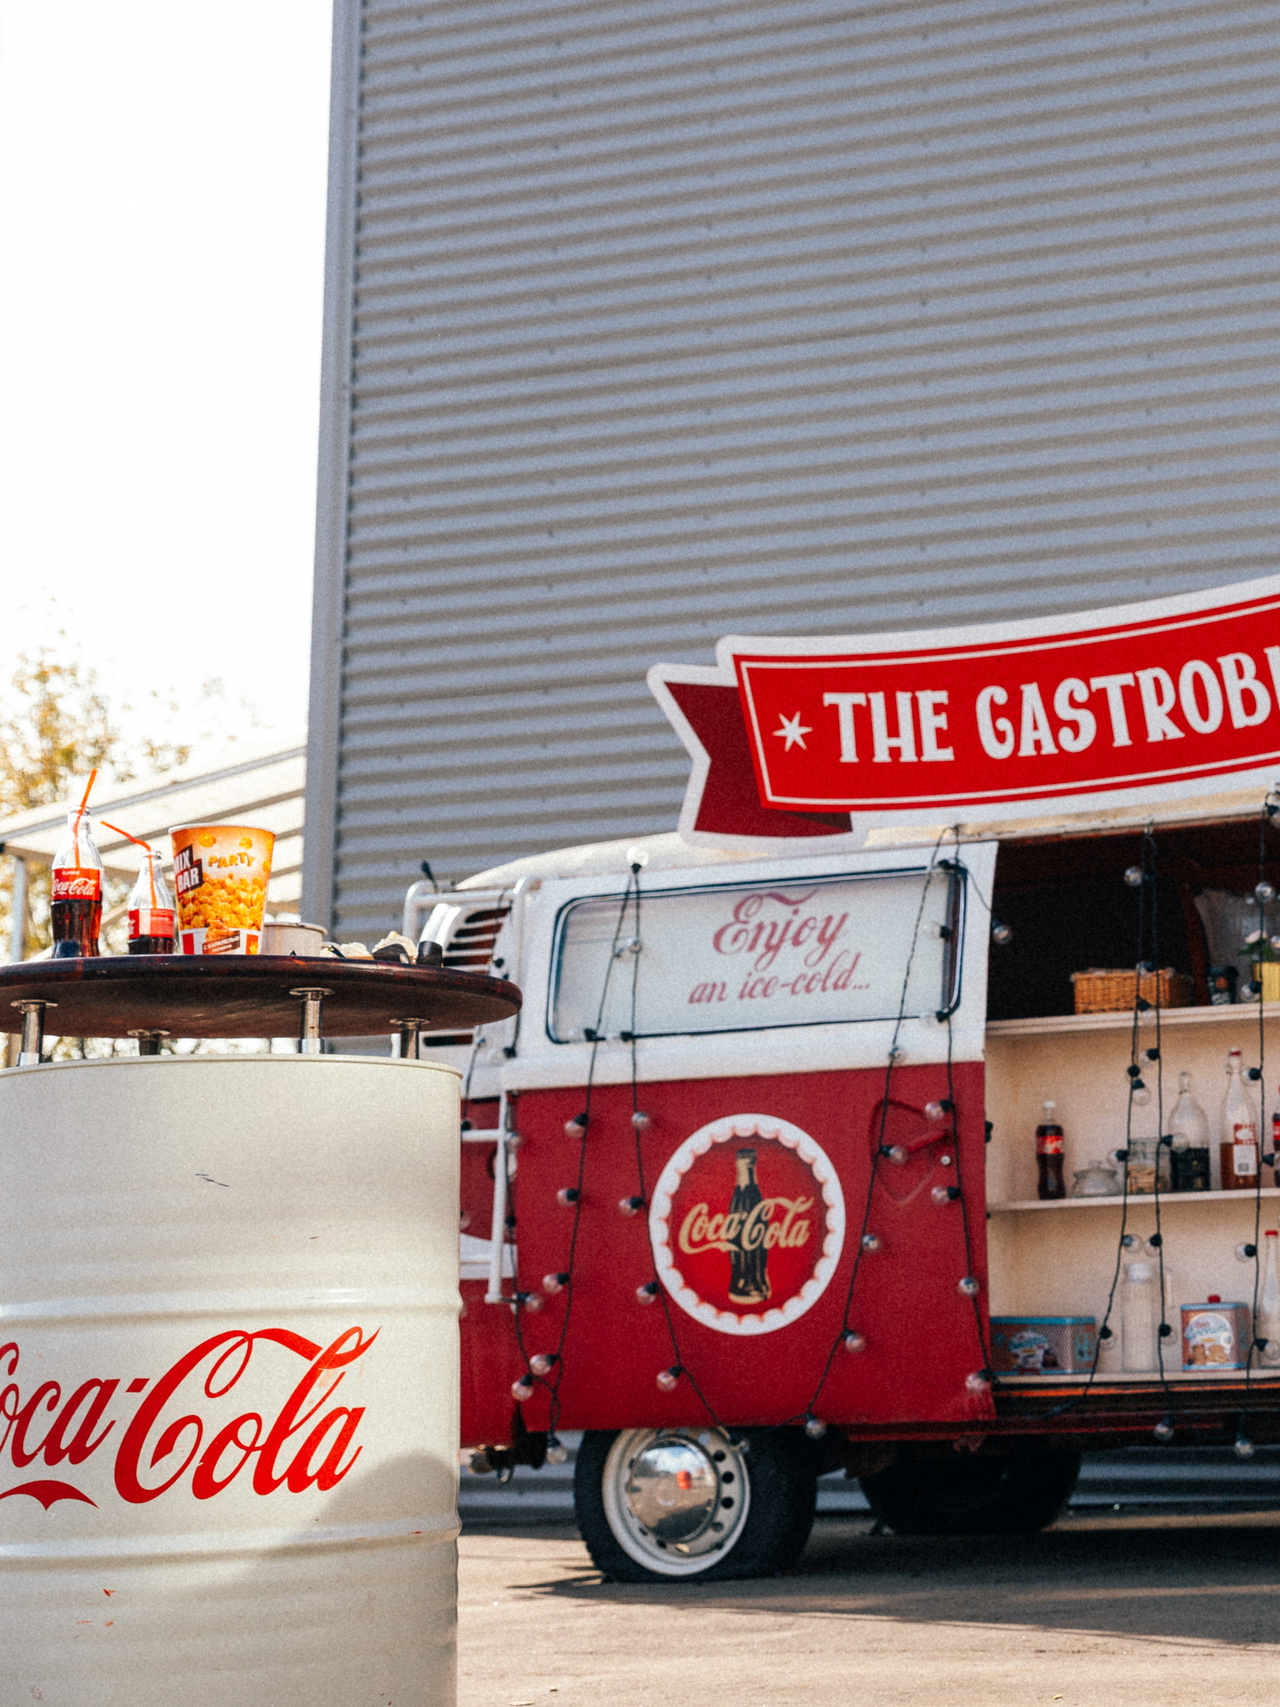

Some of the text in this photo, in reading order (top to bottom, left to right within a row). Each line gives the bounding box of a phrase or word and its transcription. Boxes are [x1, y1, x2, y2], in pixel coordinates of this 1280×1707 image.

[822, 690, 954, 763] THE
[174, 849, 191, 872] MIX
[208, 852, 256, 868] PARTY
[177, 867, 200, 893] BAR
[712, 889, 850, 972] Enjoy
[688, 981, 727, 1005] an
[678, 1195, 814, 1255] Coca-Cola
